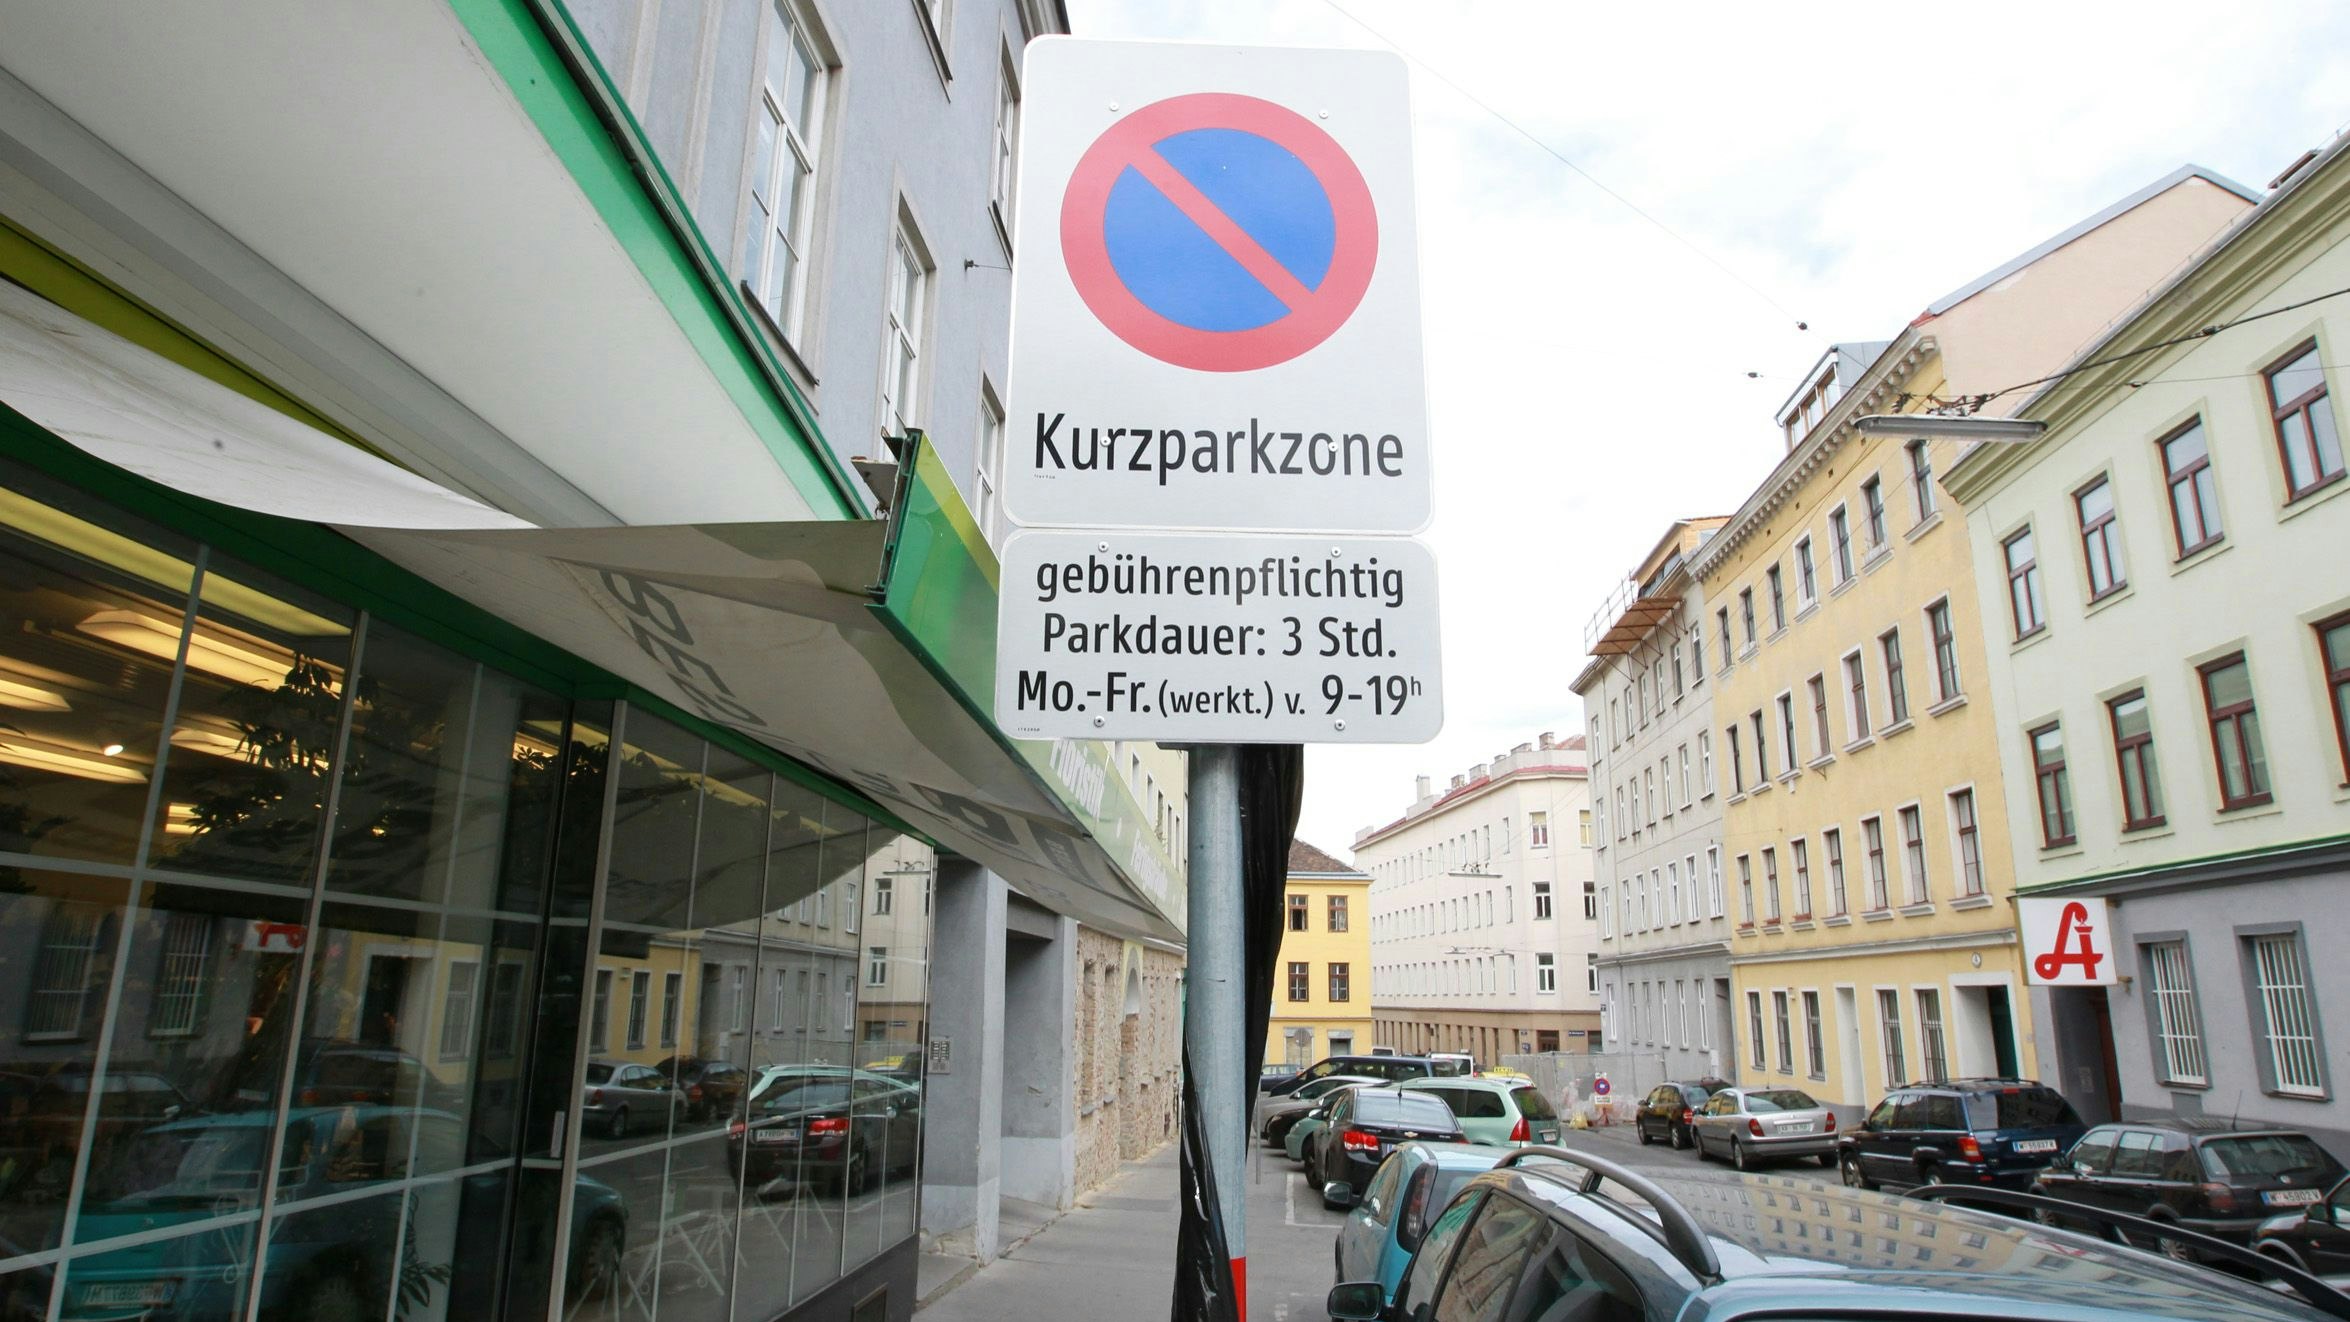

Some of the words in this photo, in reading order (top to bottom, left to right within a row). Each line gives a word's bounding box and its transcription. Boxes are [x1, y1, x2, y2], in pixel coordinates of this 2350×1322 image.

[1035, 412, 1403, 485] Kurzparkzone
[1036, 554, 1403, 608] gebührenpflichtig
[1043, 612, 1266, 656] Parkdauer:
[1282, 616, 1302, 657] 3
[1318, 616, 1397, 658] Std.
[1284, 692, 1306, 715] v.
